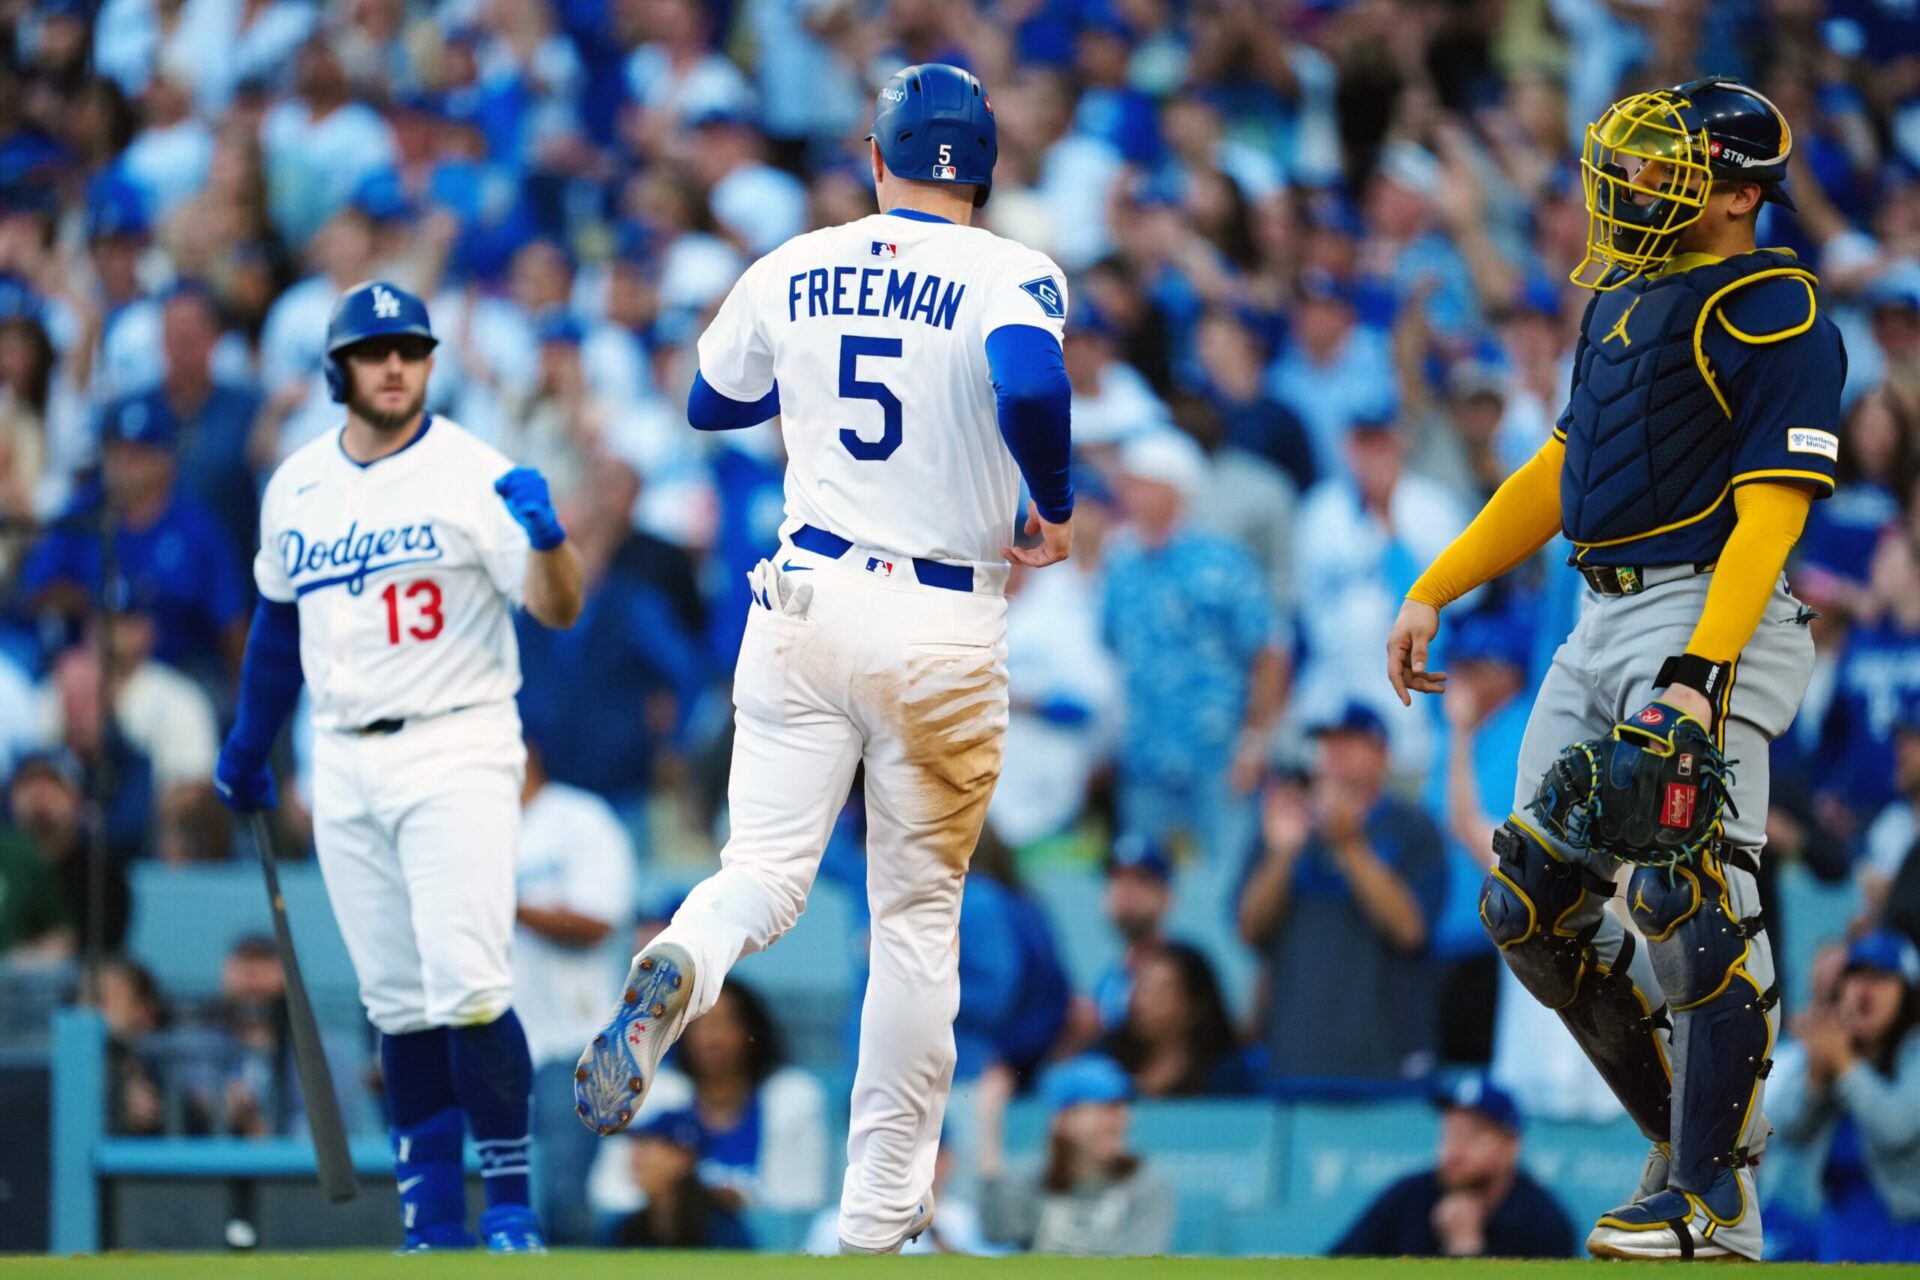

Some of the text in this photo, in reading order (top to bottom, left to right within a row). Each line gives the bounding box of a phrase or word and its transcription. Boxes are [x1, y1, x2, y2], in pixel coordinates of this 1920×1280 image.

[938, 144, 952, 165] 5
[371, 285, 401, 319] LA
[789, 266, 966, 331] FREEMAN
[839, 334, 903, 462] 5
[279, 520, 443, 598] Dodgers
[381, 578, 444, 645] 13
